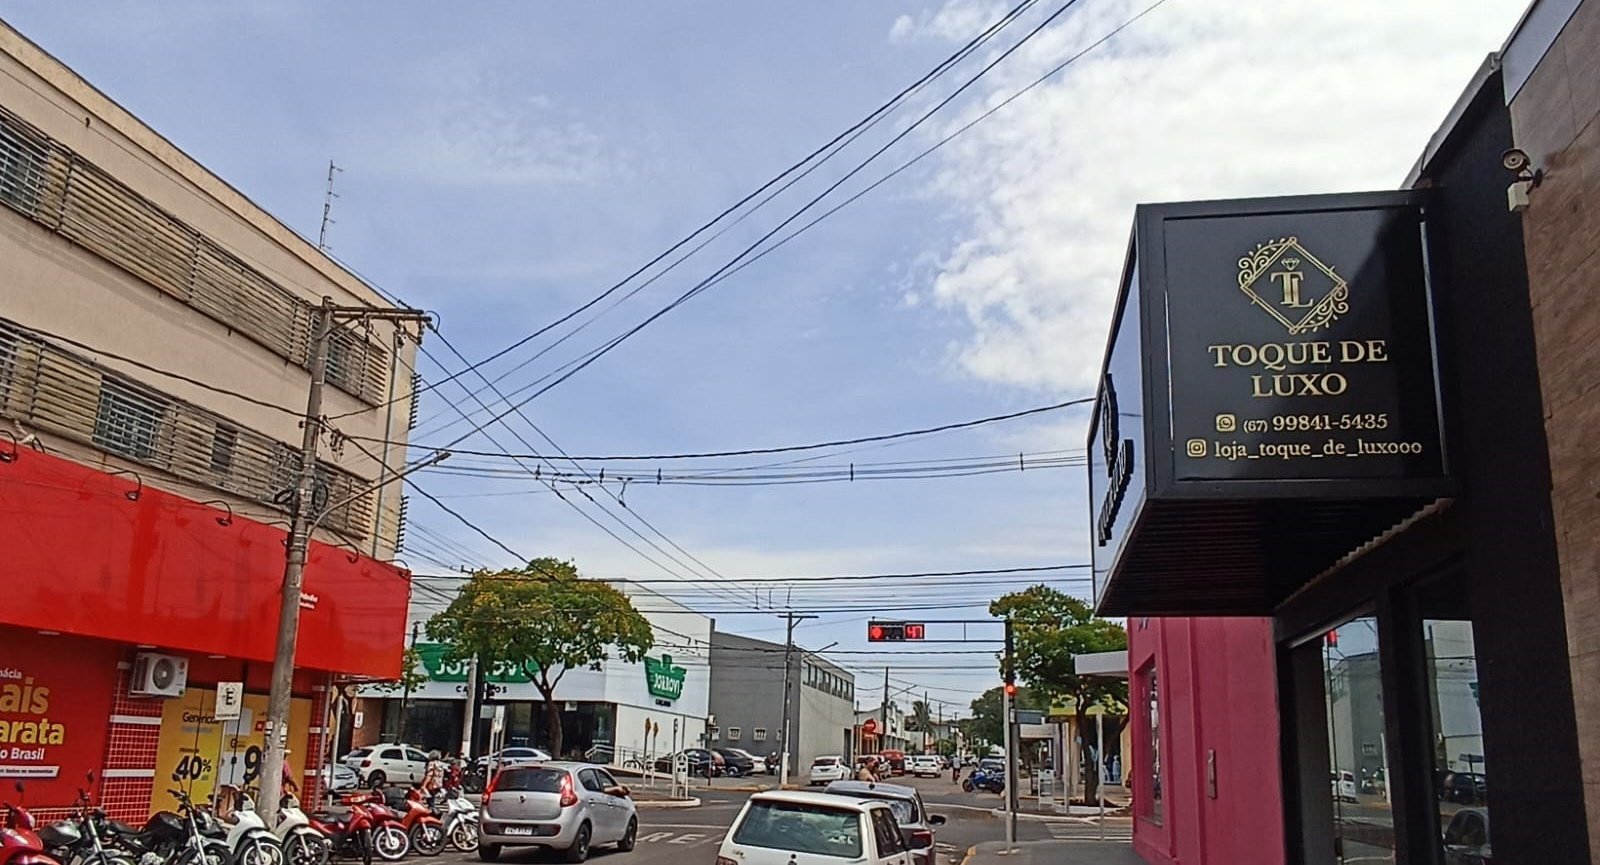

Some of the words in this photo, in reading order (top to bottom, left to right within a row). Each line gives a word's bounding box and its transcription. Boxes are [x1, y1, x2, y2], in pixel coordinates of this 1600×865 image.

[1208, 341, 1332, 371] TOQUE
[1340, 340, 1388, 363] DE
[1252, 372, 1347, 397] LUXO
[1243, 420, 1268, 433] (67)
[1272, 413, 1388, 432] 99841-5435
[1215, 439, 1422, 461] loja_toque_de_luxooo
[10, 747, 45, 760] Brasil
